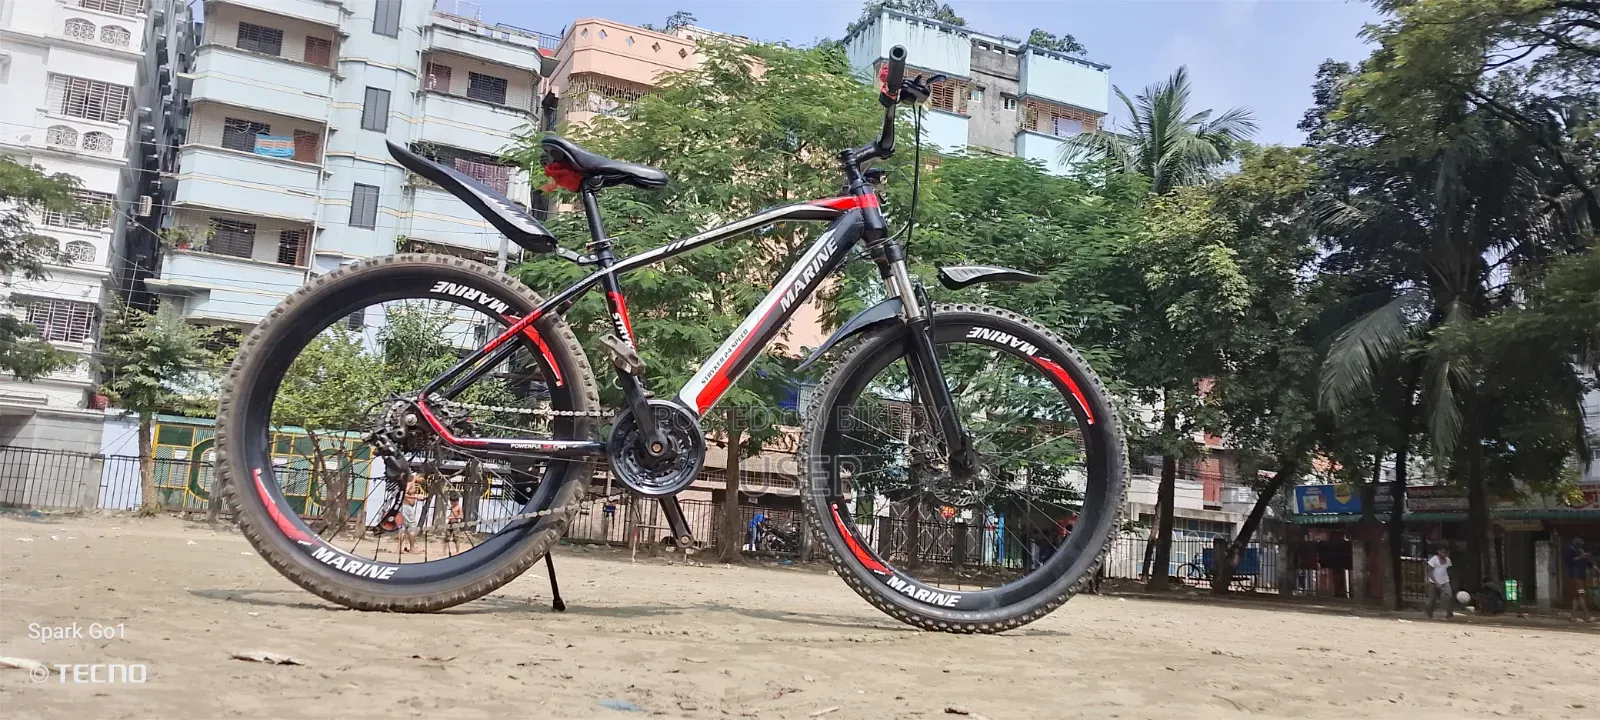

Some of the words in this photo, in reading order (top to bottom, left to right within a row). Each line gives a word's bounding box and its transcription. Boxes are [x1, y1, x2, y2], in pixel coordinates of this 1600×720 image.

[779, 237, 839, 313] MARINE
[430, 280, 509, 315] MARINE
[612, 312, 636, 352] STRYK
[966, 326, 1039, 356] MARINE
[701, 356, 725, 384] STRYKER
[724, 347, 733, 358] 24
[731, 328, 749, 348] SPEED
[311, 546, 399, 580] MARINE
[886, 576, 962, 607] MARINE
